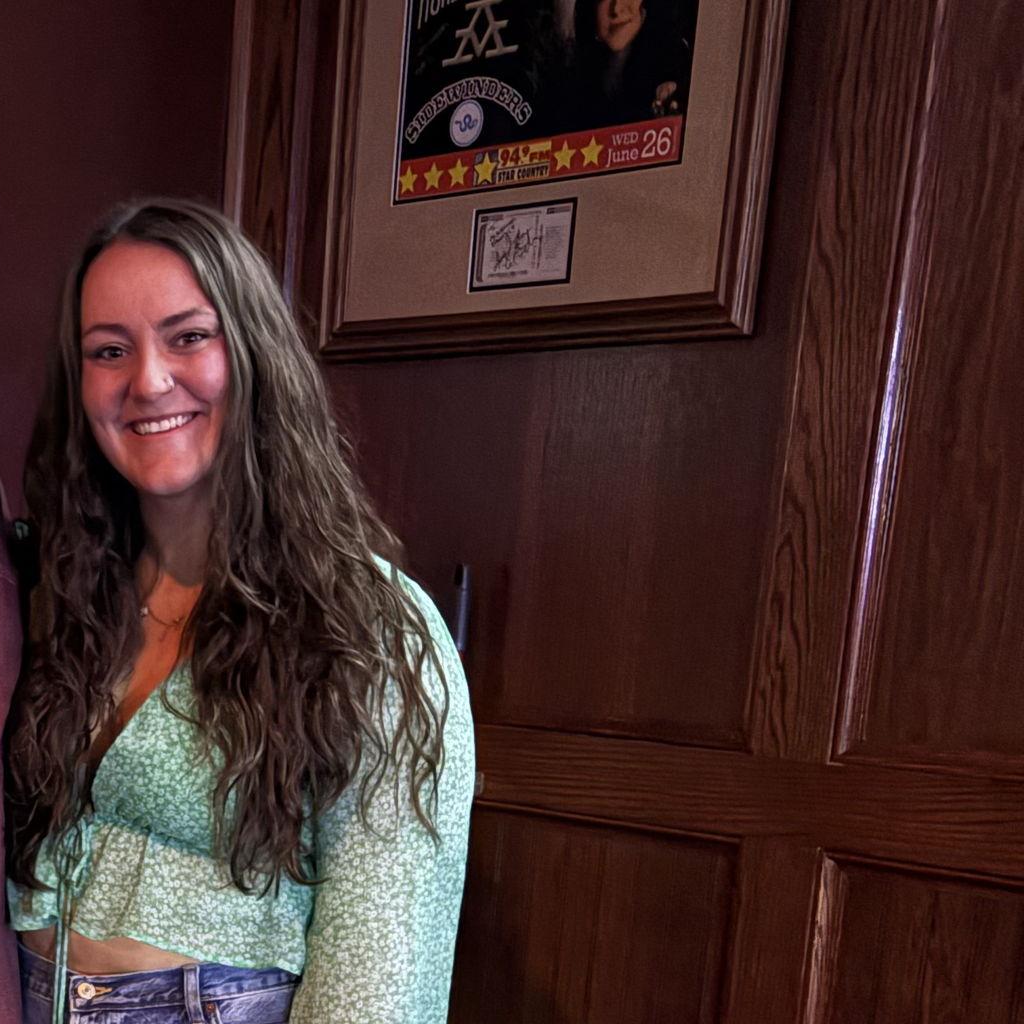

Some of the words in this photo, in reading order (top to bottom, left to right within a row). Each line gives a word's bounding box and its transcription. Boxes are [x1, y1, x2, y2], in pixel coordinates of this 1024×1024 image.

[405, 76, 532, 144] SIDEWINDERS
[606, 147, 639, 168] June
[641, 126, 672, 159] 26
[612, 131, 639, 146] WED
[498, 169, 515, 183] STAR
[517, 165, 549, 179] COUNTRY
